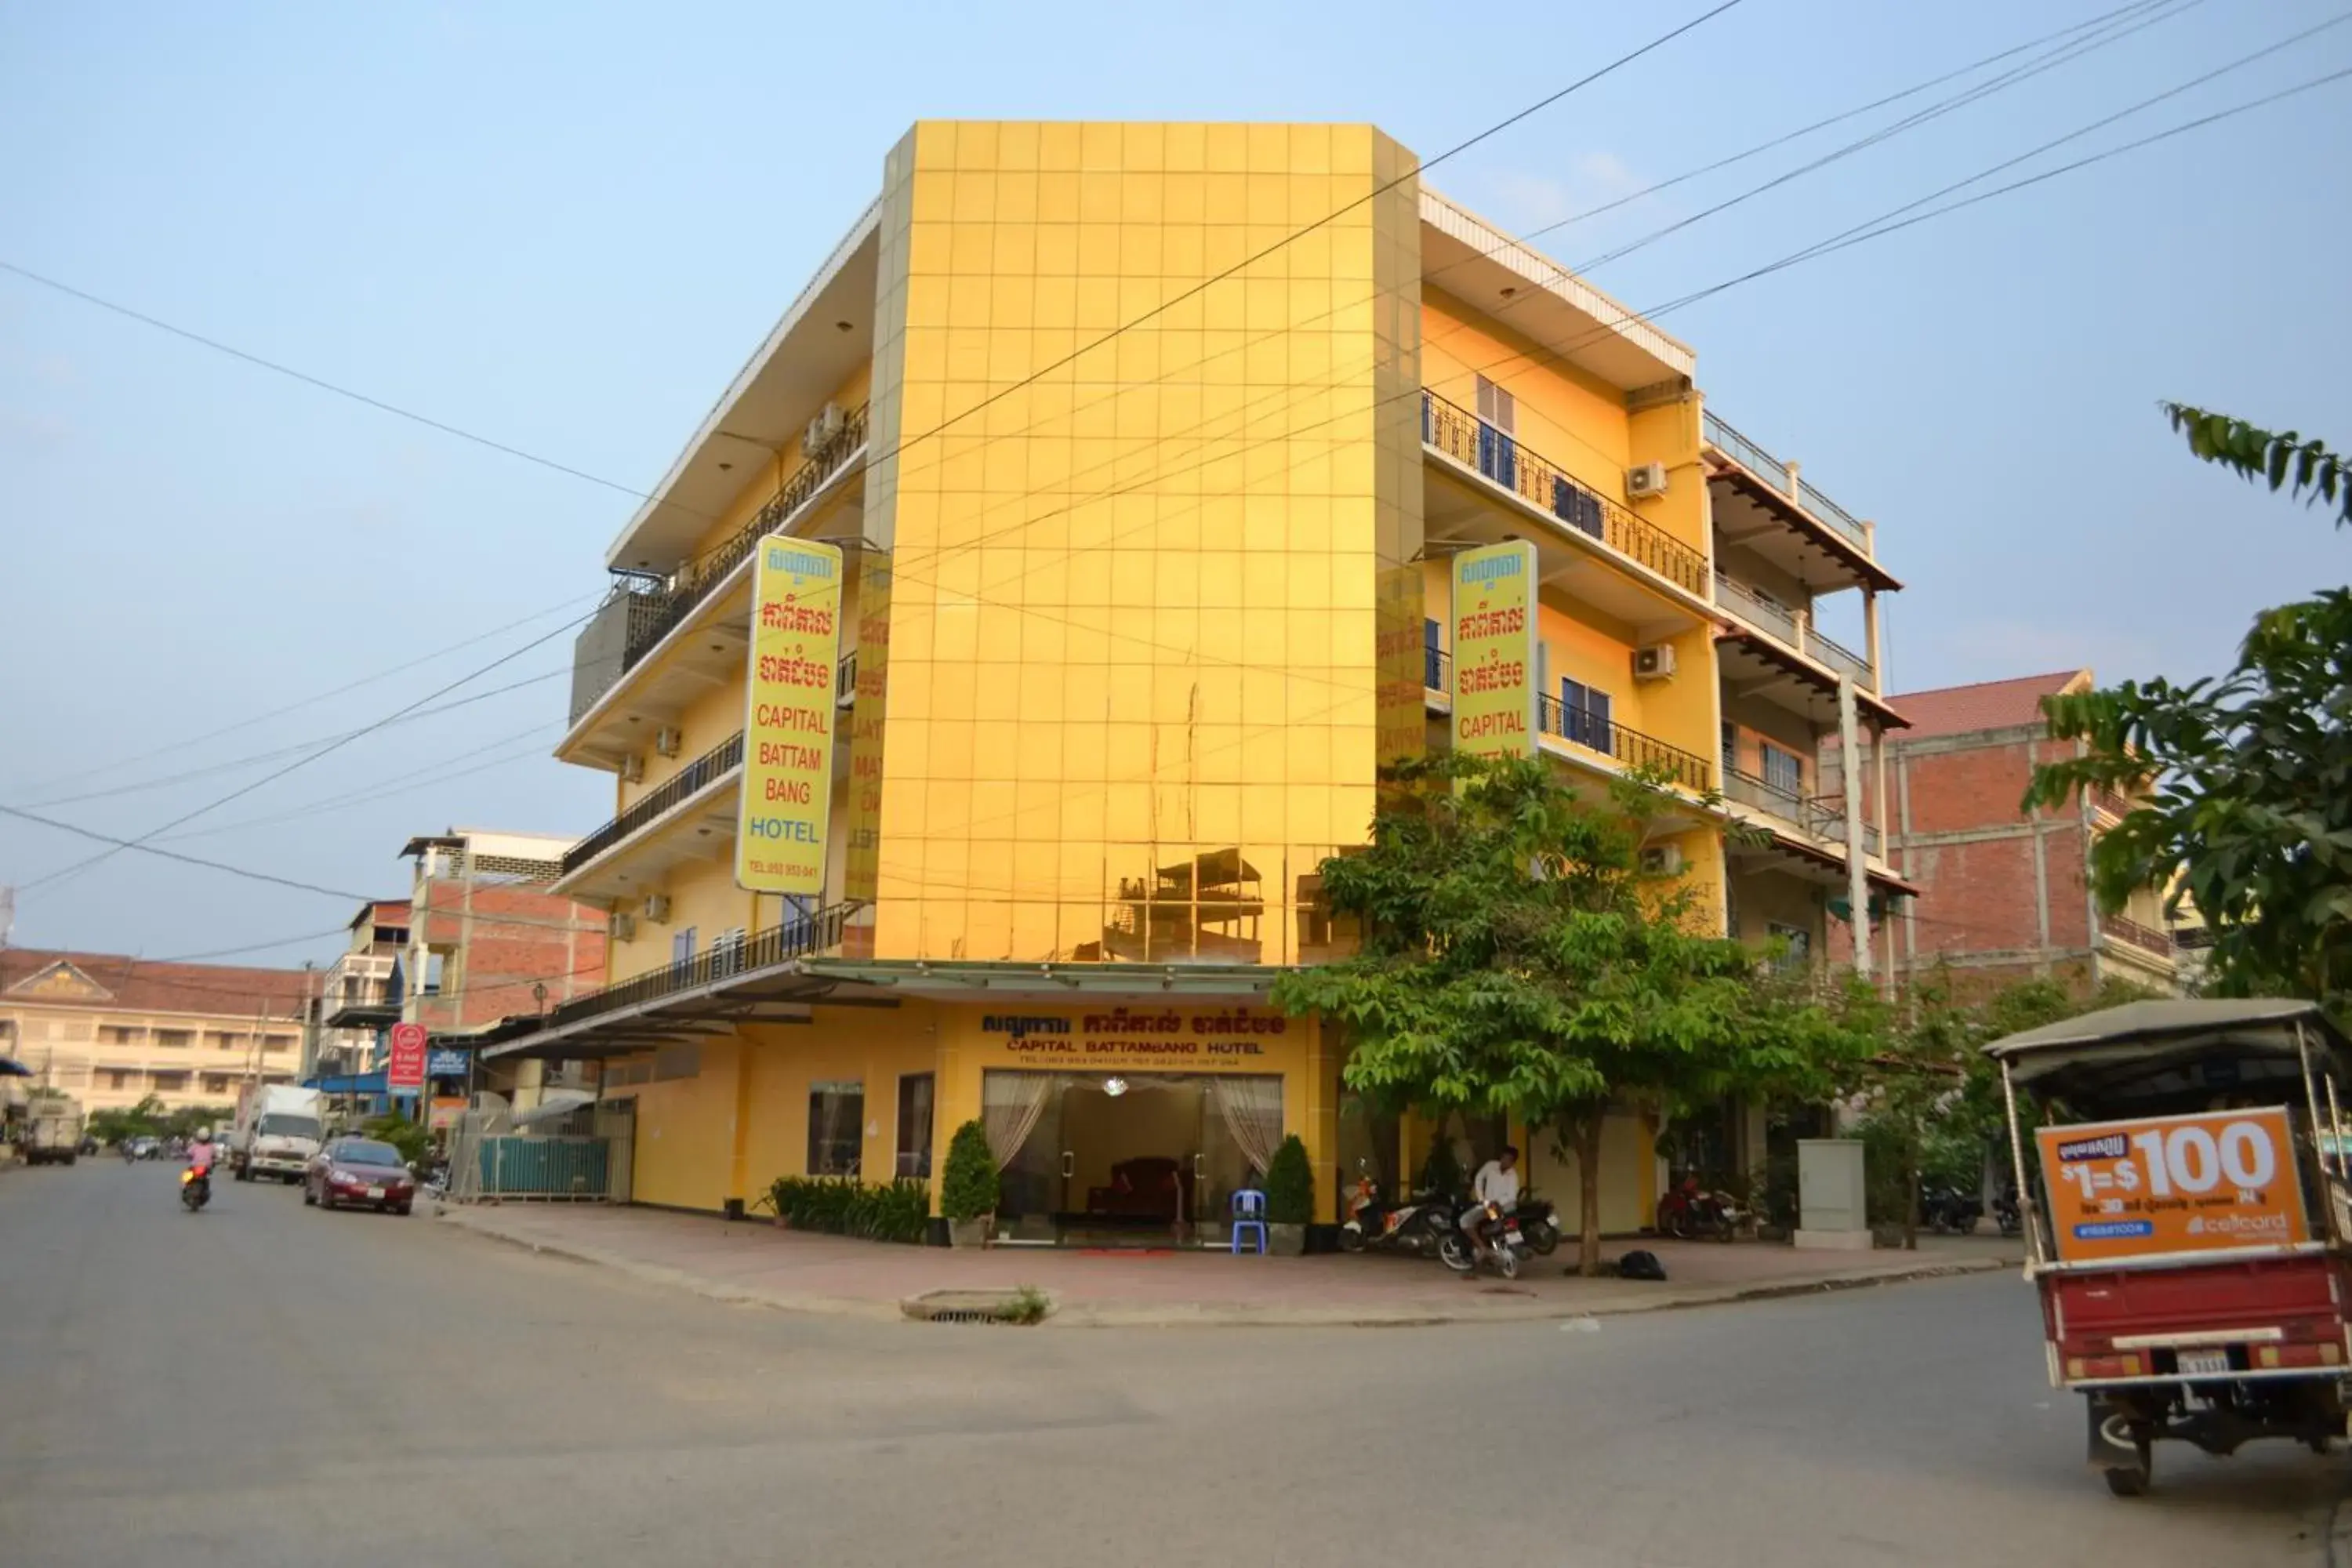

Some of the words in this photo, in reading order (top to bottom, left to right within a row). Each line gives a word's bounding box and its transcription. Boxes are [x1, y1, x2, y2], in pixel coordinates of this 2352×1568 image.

[757, 704, 828, 735] CAPITAL
[1459, 710, 1526, 739] CAPITAL
[759, 742, 822, 771] BATTAM
[765, 778, 811, 804] BANG
[750, 816, 819, 844] HOTEL
[1007, 1040, 1077, 1052] CAPITAL
[1085, 1041, 1198, 1054] BATTAMBANG
[1207, 1043, 1265, 1054] HOTEL
[2205, 1210, 2287, 1233] cellcard
